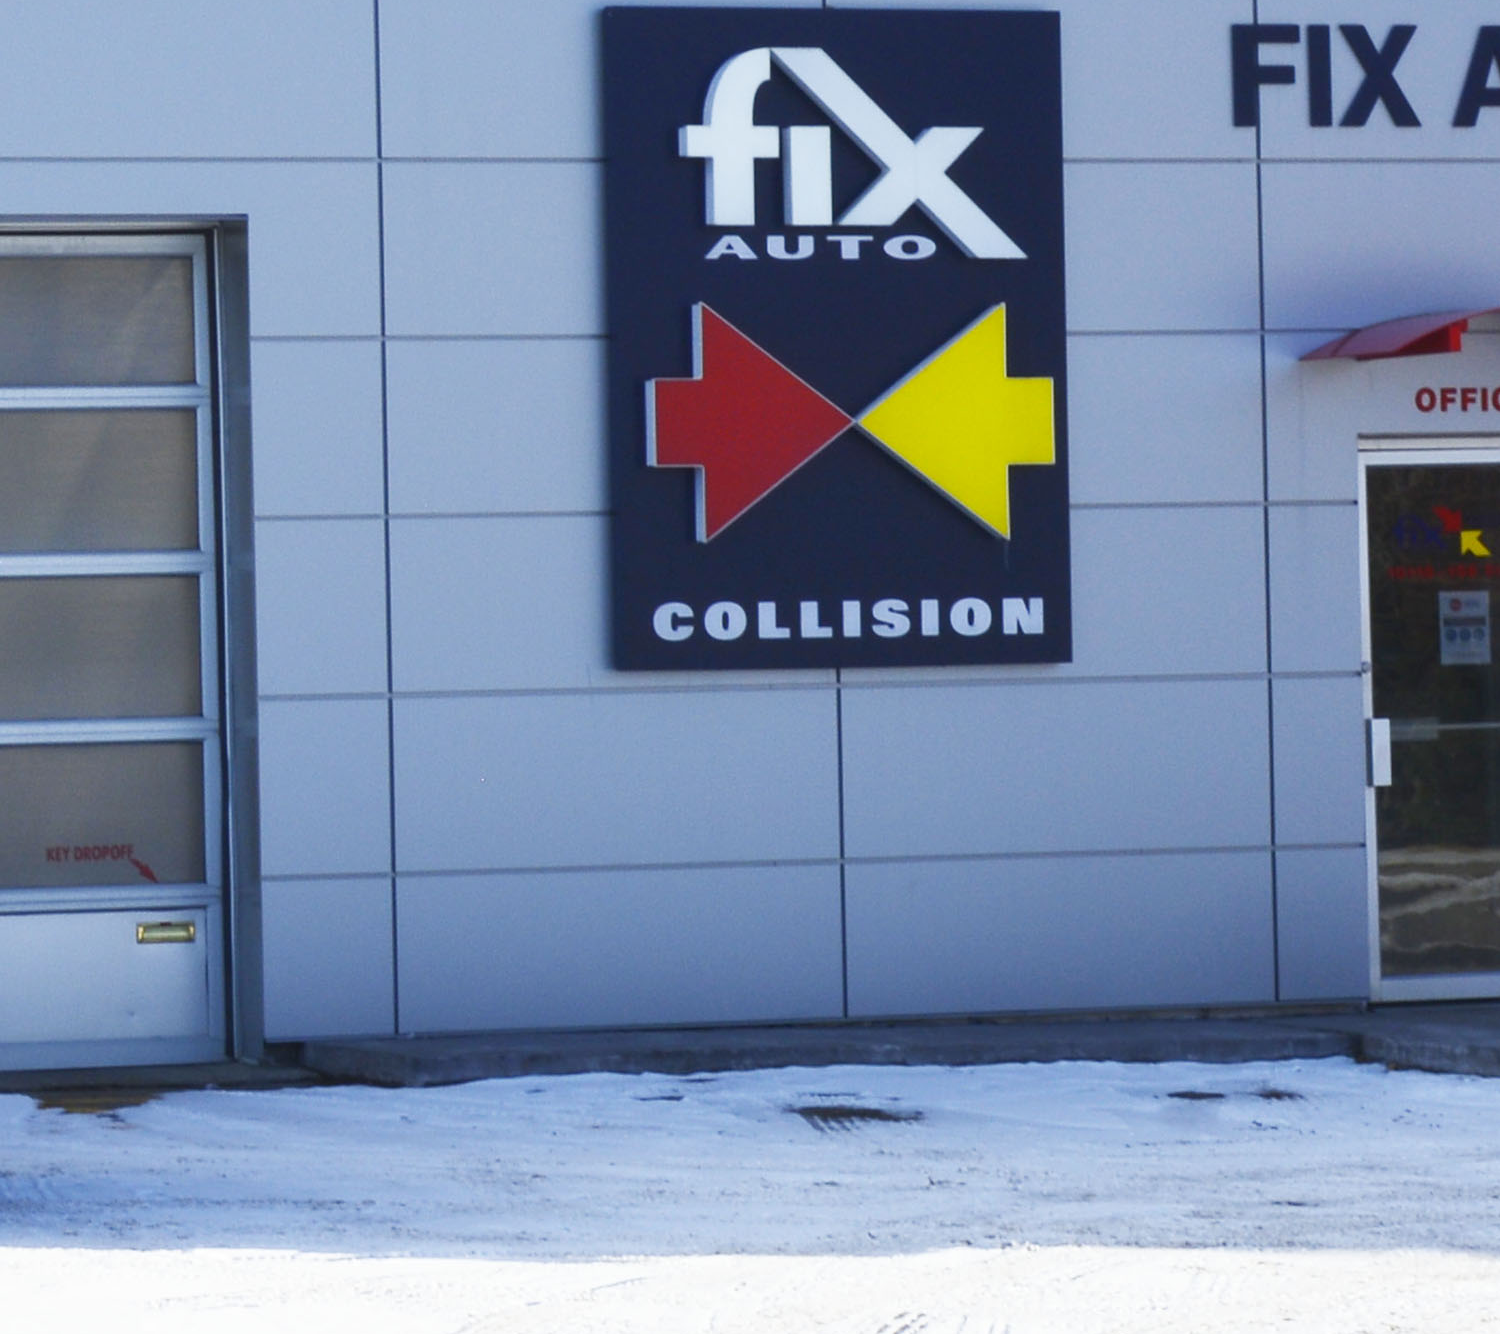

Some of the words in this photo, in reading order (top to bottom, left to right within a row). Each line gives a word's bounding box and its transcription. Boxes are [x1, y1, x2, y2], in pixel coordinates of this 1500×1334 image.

[1230, 23, 1421, 128] FIX
[678, 47, 1028, 259] fix
[704, 234, 937, 260] AUTO
[653, 597, 1044, 642] COLLISION
[45, 845, 71, 862] KEY
